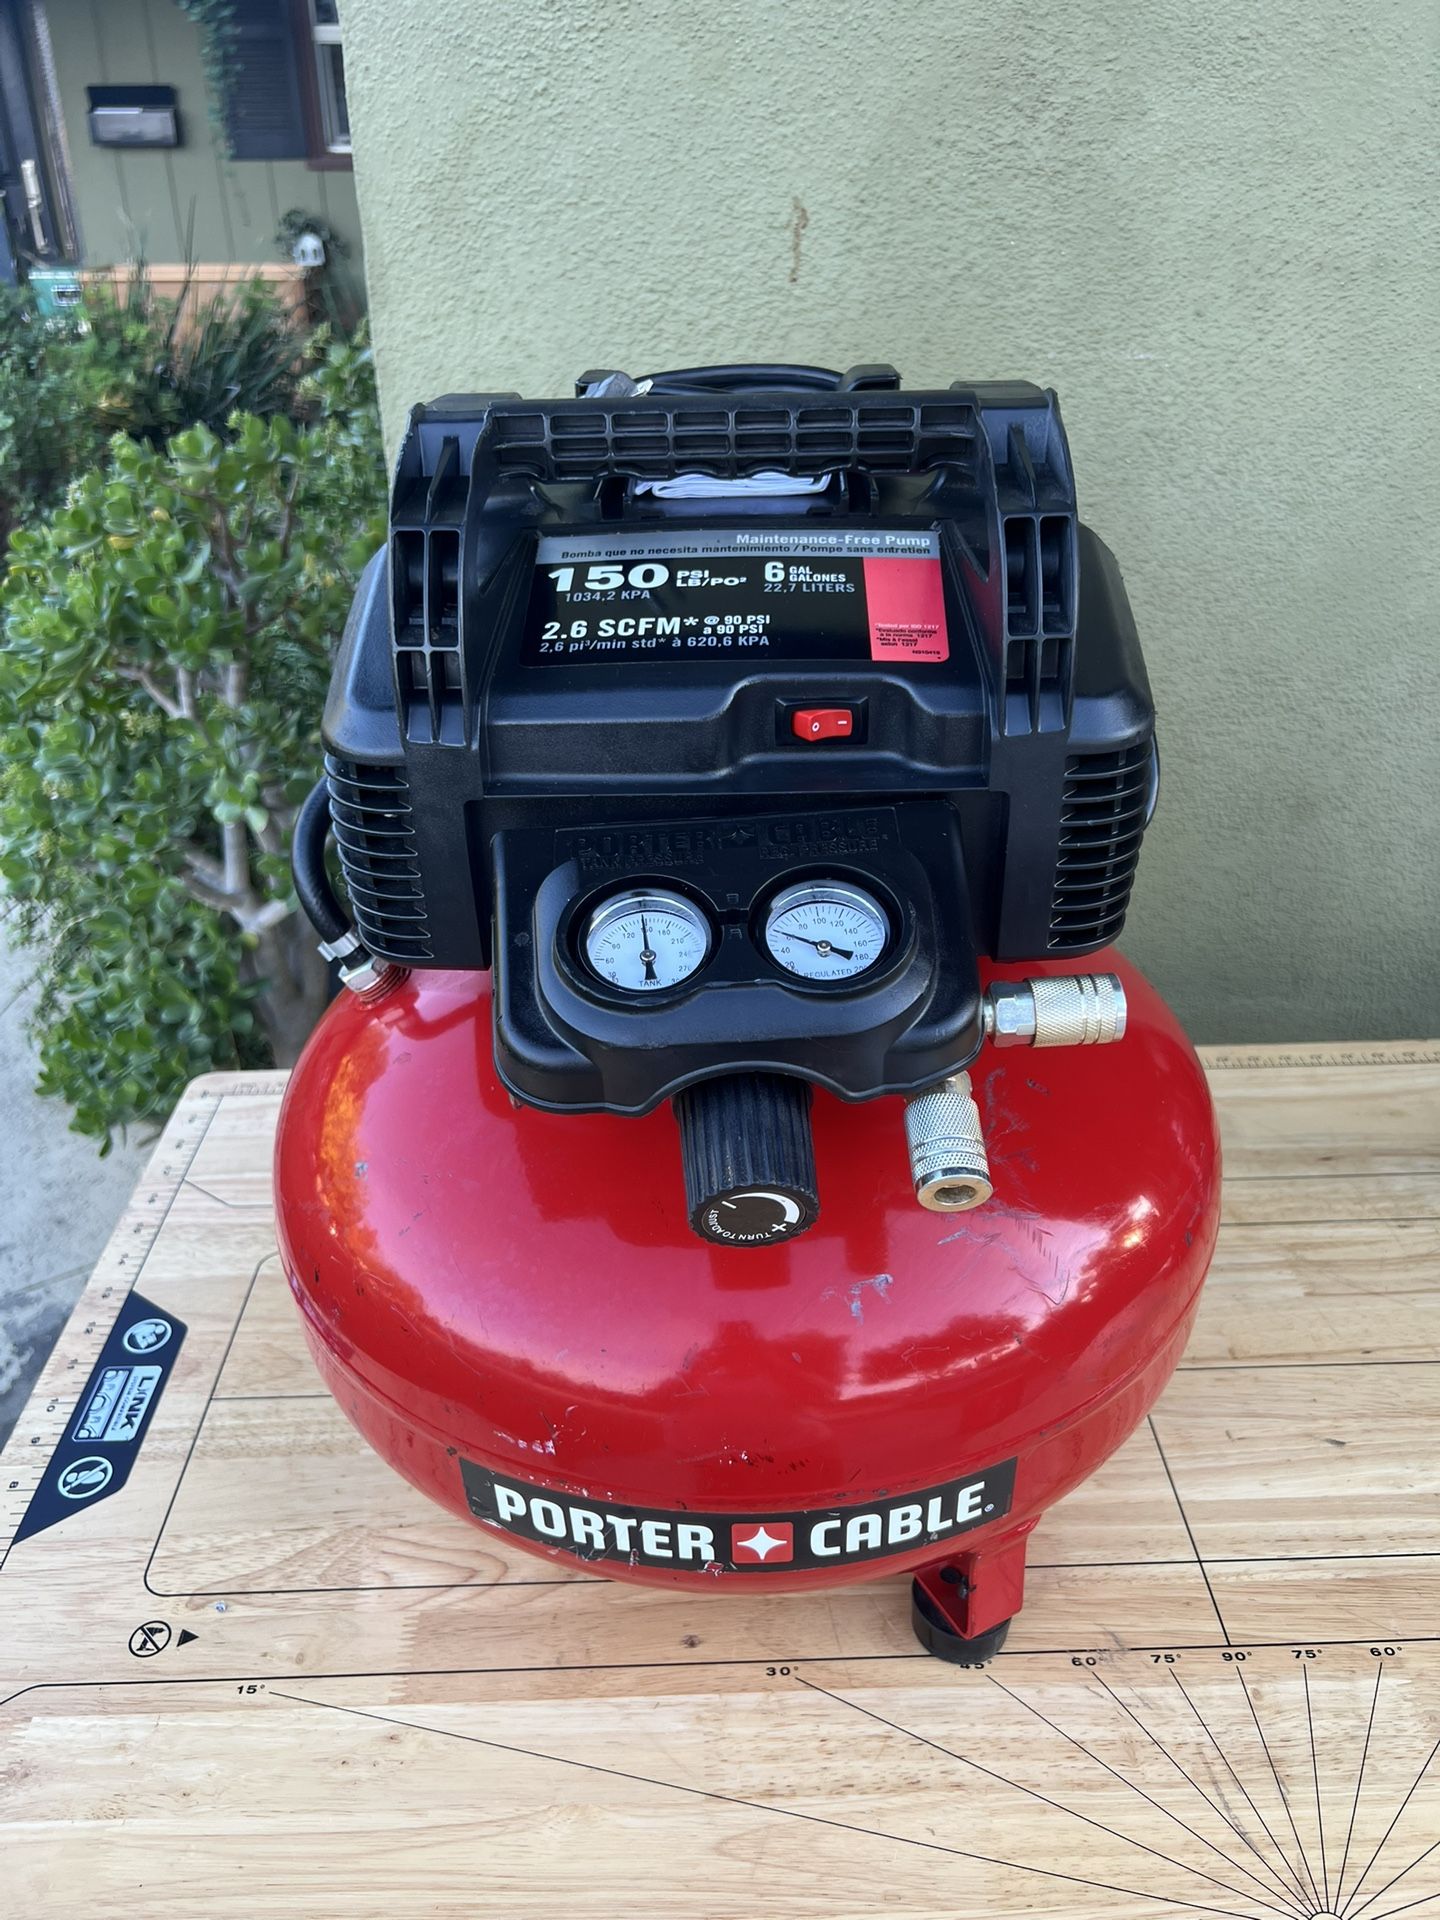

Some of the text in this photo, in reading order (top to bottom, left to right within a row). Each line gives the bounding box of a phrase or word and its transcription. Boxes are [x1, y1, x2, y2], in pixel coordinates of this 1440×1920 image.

[736, 534, 930, 547] Maintenance-Free Pump
[561, 551, 602, 559] Bomba
[648, 546, 698, 554] necesita
[702, 545, 790, 553] mantenimiento
[802, 545, 843, 554] Pompe
[764, 561, 812, 582] 6 GAL
[548, 564, 709, 592] 150 PSI
[789, 574, 846, 582] GALONES
[764, 583, 856, 594] 22,7 LITERS
[621, 590, 650, 600] KPA
[542, 620, 588, 640] 2.6
[704, 616, 720, 626] @
[724, 614, 742, 624] 90
[746, 615, 770, 624] PSI
[717, 624, 734, 634] 90
[739, 624, 763, 634] PSI
[672, 637, 682, 648] à
[688, 636, 732, 648] 620,6
[738, 636, 770, 646] KPA
[844, 928, 858, 936] 140
[804, 968, 852, 979] REGULATED
[639, 980, 662, 988] TANK
[708, 1209, 772, 1240] TURN TO ADJUST
[494, 1484, 716, 1560] PORTER
[1222, 1652, 1252, 1662] 90°
[1291, 1649, 1322, 1659] 75°
[1370, 1646, 1402, 1657] 60°
[1150, 1654, 1182, 1664] 75°
[766, 1666, 799, 1676] 30°
[237, 1684, 265, 1694] 15°
